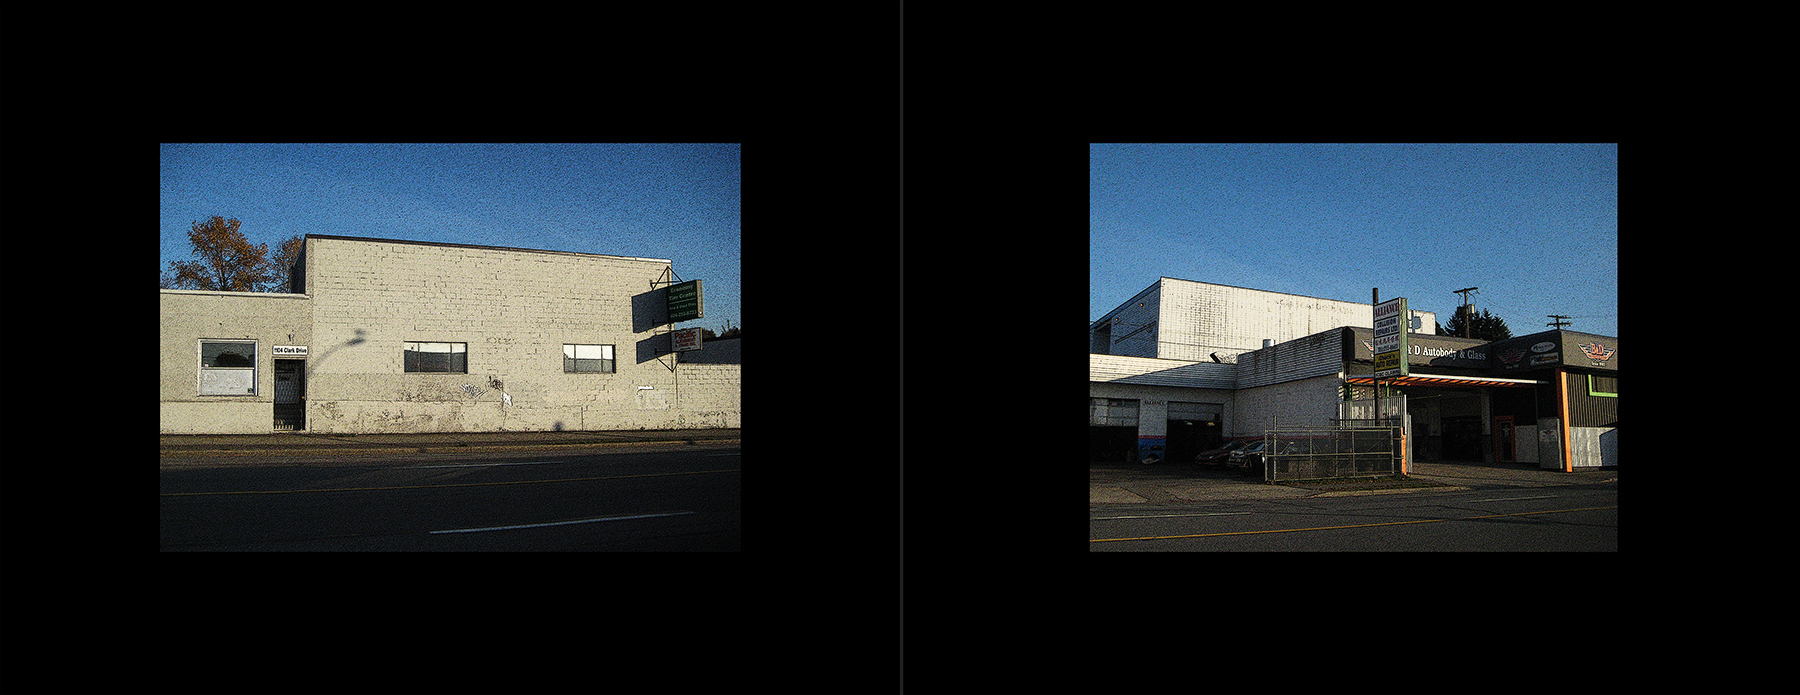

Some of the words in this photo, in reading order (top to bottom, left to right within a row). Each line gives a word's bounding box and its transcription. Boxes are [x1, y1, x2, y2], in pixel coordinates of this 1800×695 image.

[1375, 303, 1399, 317] ALLIANCE
[1376, 318, 1396, 328] COLLISION
[1375, 327, 1390, 336] REPAIRS
[1414, 345, 1421, 355] D
[1423, 346, 1457, 360] Autobody
[1459, 349, 1466, 359] &
[1467, 350, 1486, 360] Glass
